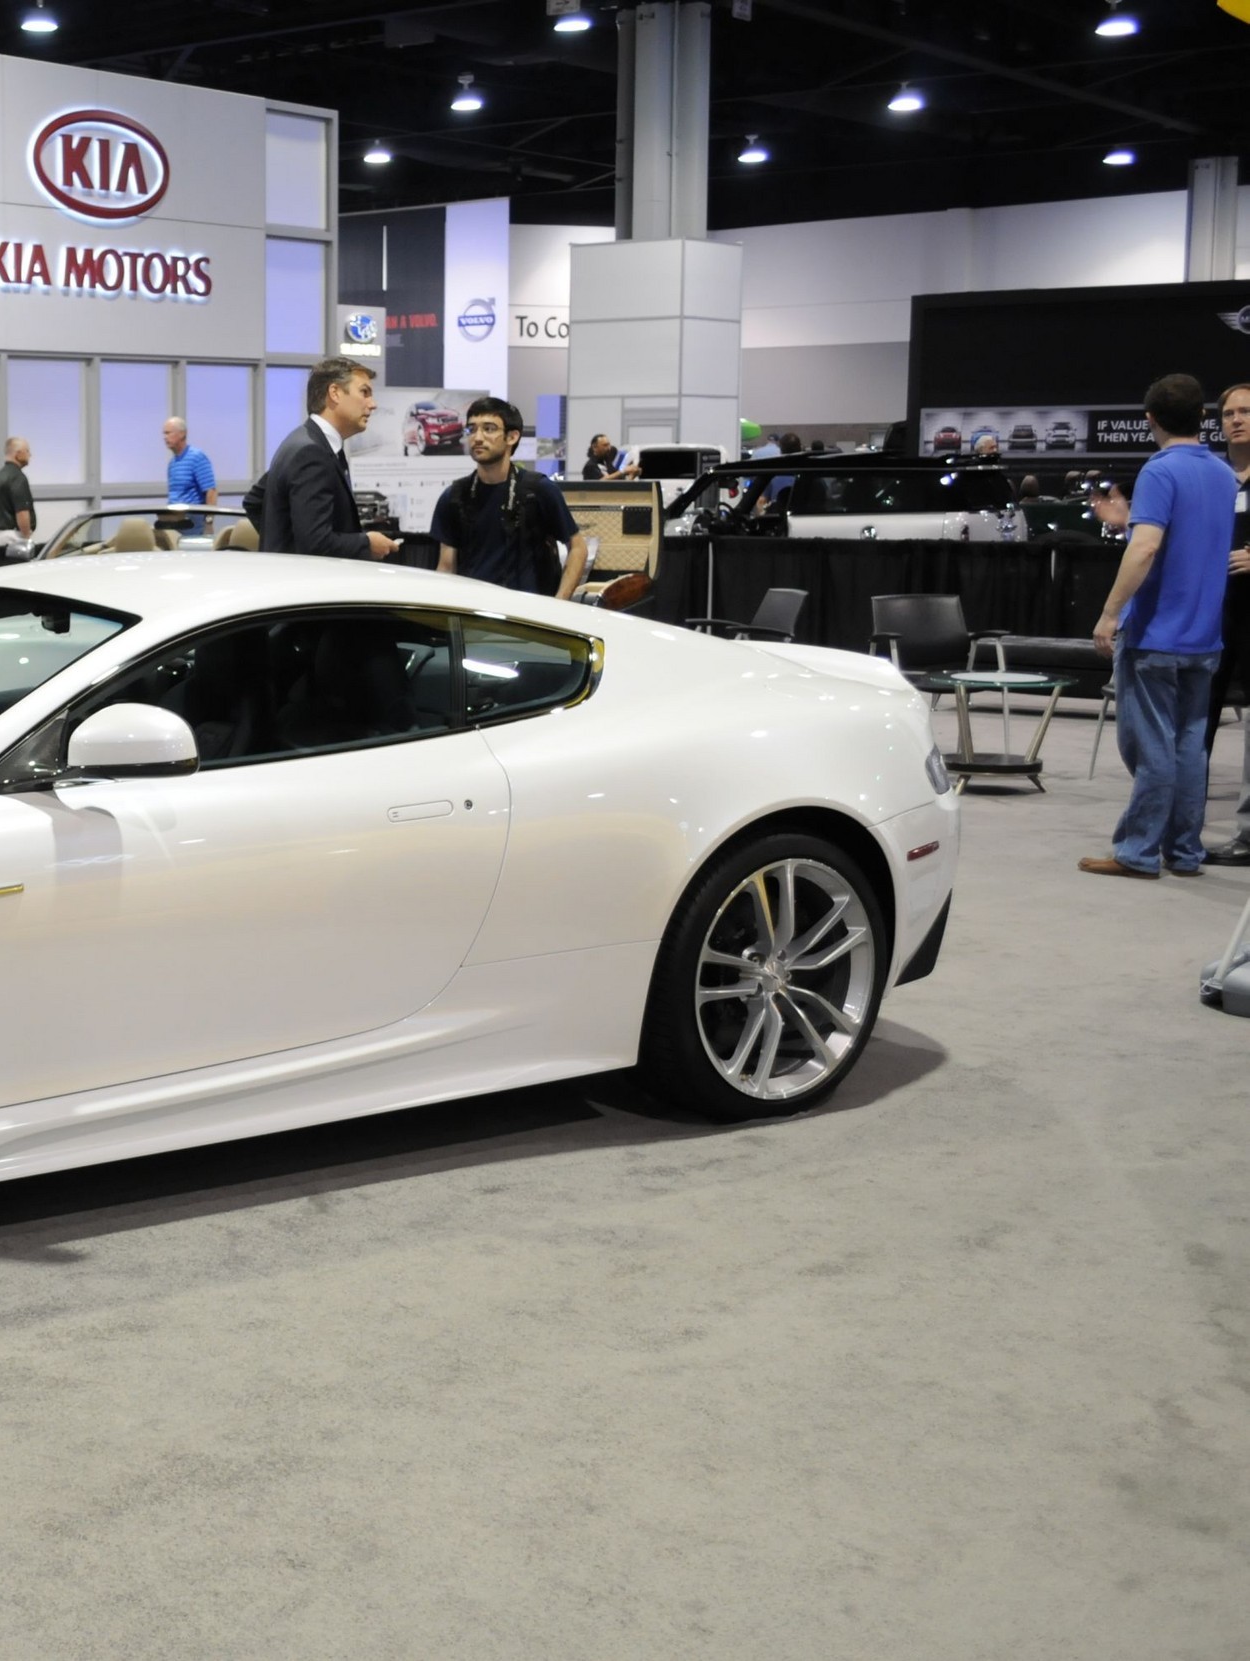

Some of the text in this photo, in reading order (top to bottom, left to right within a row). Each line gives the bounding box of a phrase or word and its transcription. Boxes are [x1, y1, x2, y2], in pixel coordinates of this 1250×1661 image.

[60, 133, 149, 195] KIA
[64, 246, 212, 297] MOTORS
[460, 315, 494, 326] VOLVO
[515, 315, 539, 339] To
[1097, 420, 1108, 431] IF
[1111, 420, 1149, 430] VALUE
[1097, 432, 1129, 443] THEN
